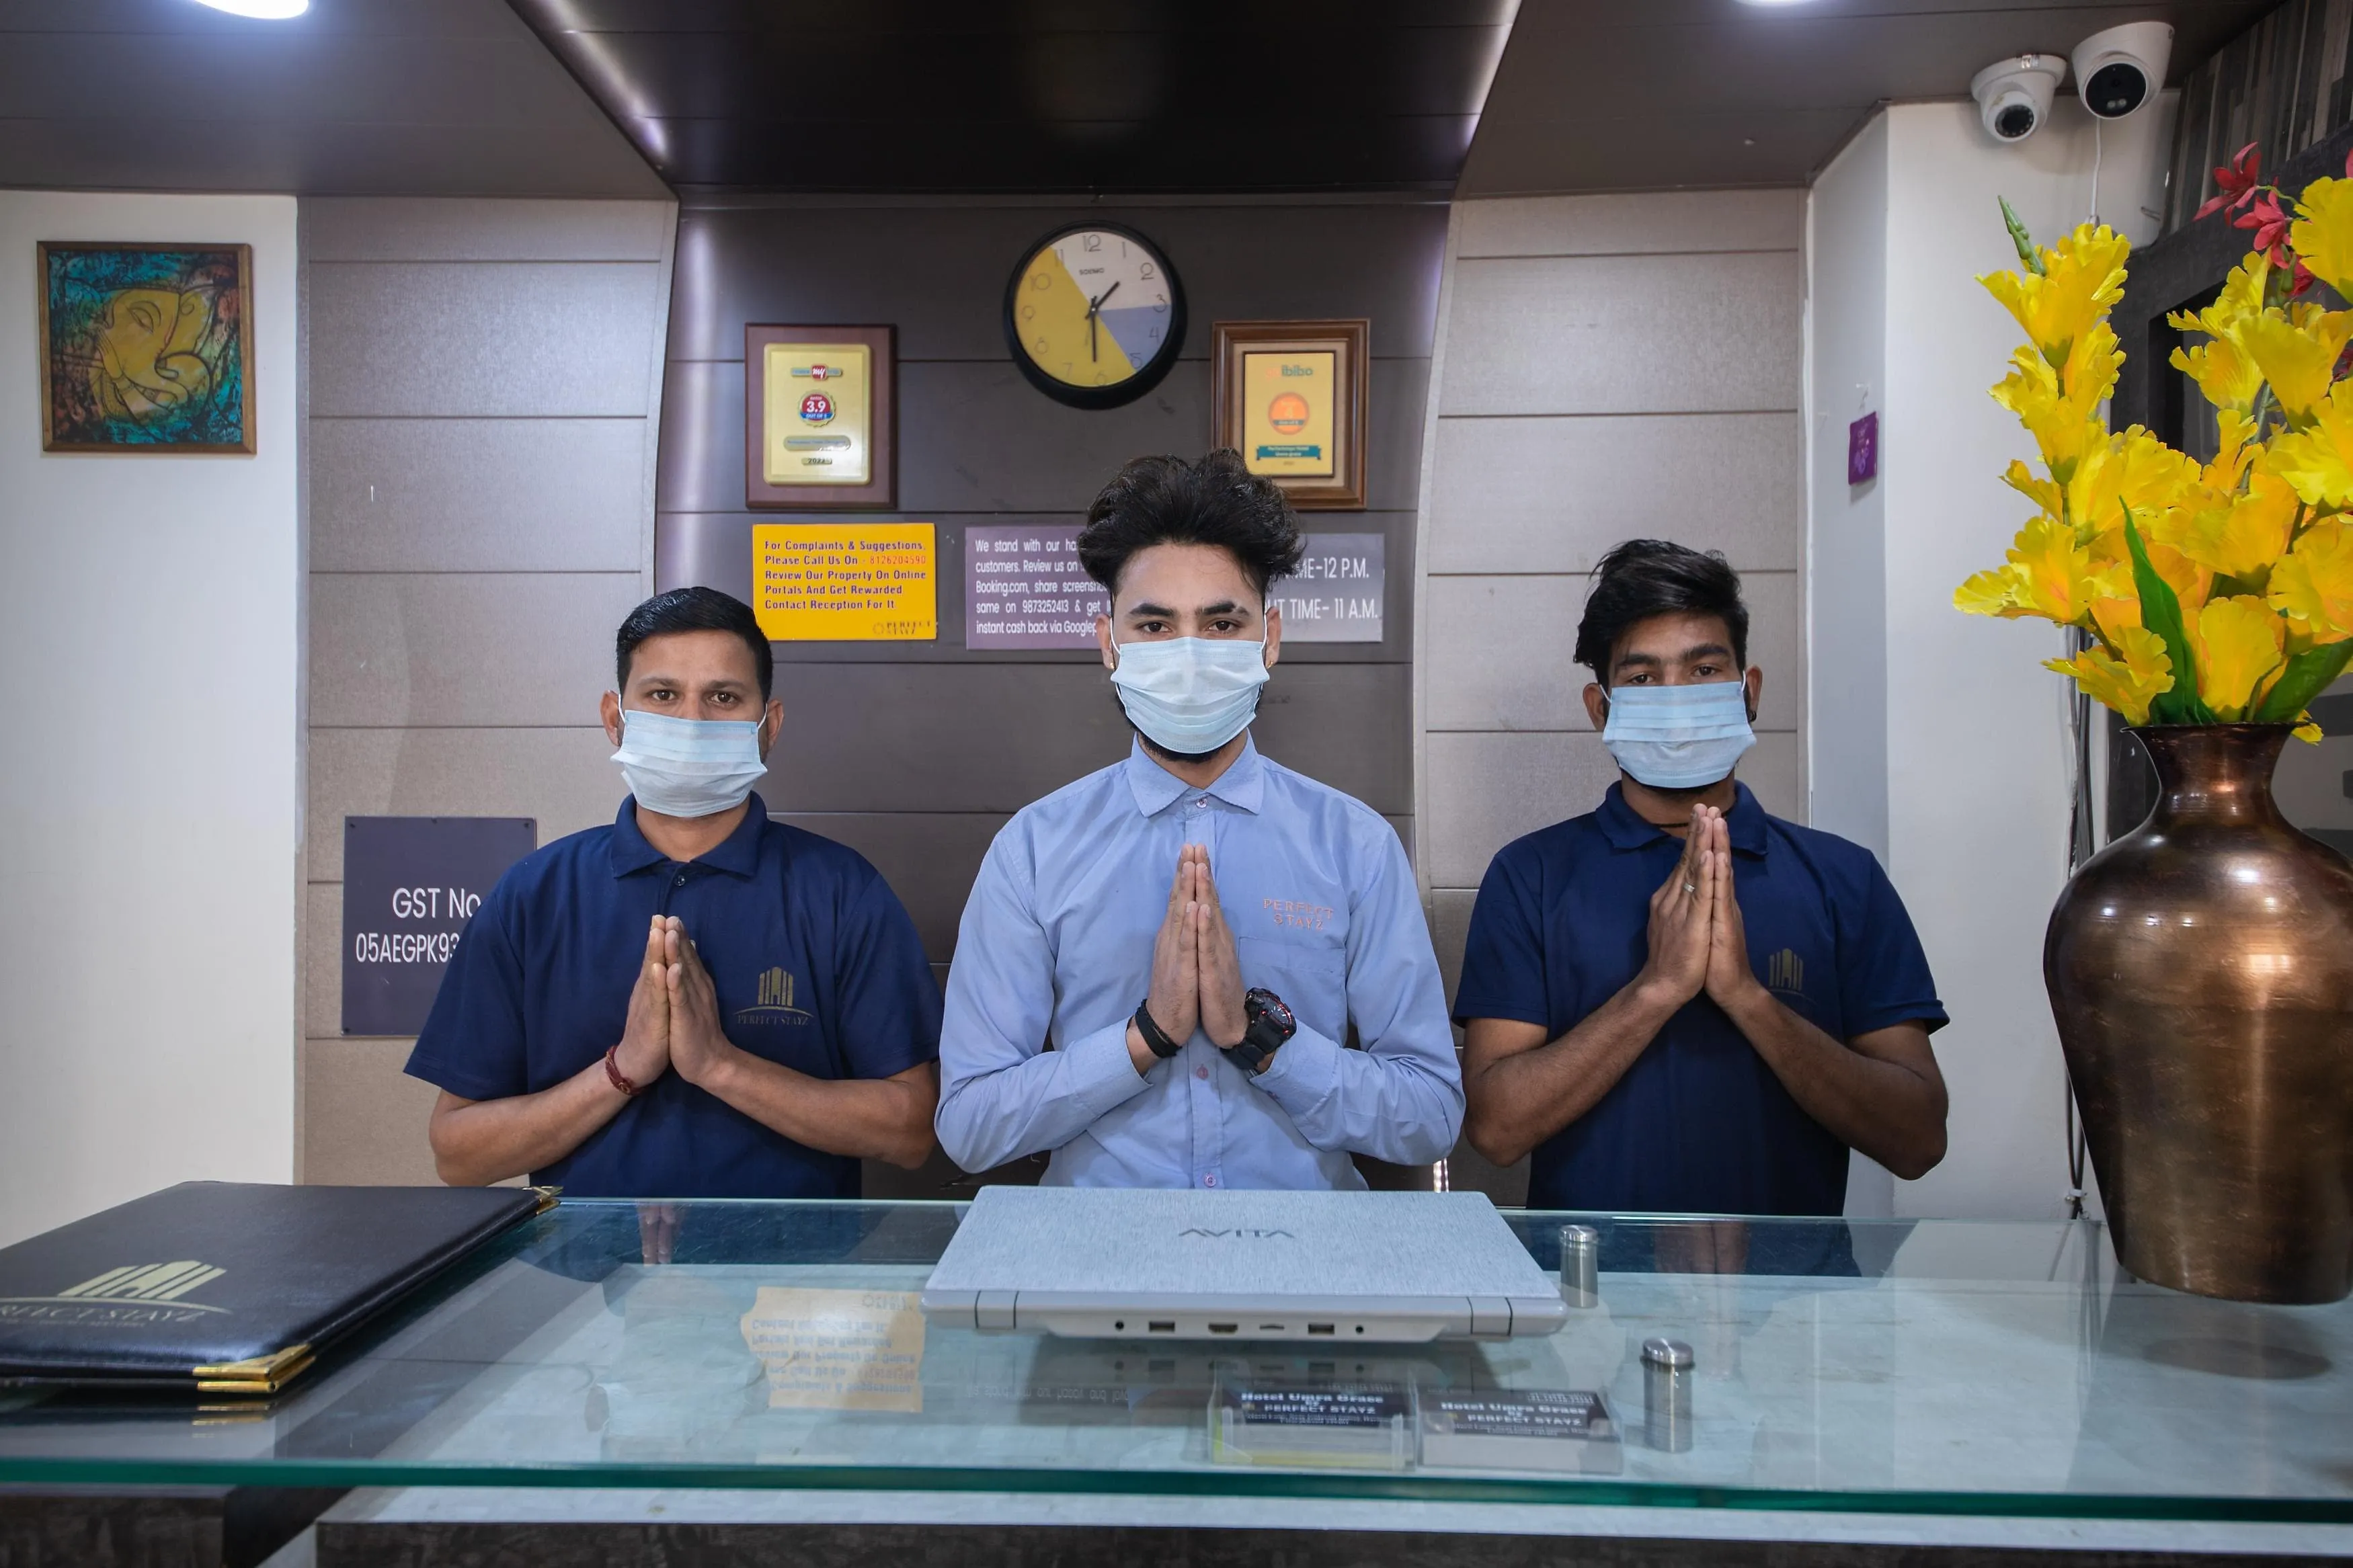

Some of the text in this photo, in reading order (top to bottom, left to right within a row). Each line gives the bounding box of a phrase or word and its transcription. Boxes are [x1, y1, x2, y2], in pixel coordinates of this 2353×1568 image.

[1083, 235, 1101, 252] 12
[1122, 242, 1126, 258] 1
[1055, 249, 1064, 267] 11
[1140, 262, 1154, 280] 2
[1031, 274, 1051, 292] 10
[1152, 294, 1167, 313] 3
[1021, 305, 1035, 321] 9
[1149, 327, 1160, 344] 4
[1034, 337, 1048, 354] 8
[1129, 353, 1144, 369] 5
[1062, 362, 1073, 378] 7
[1094, 370, 1108, 386] 6
[807, 401, 826, 413] 3.9
[764, 541, 781, 550] For
[785, 541, 844, 551] Complaints
[848, 541, 854, 550] &
[975, 540, 990, 552] We
[994, 540, 1018, 552] stand
[1024, 539, 1041, 552] with
[1046, 541, 1060, 551] our
[764, 556, 799, 565] Please
[804, 556, 824, 565] Call
[828, 556, 840, 565] Us
[844, 556, 858, 565] On
[870, 555, 926, 565] 8126204590
[975, 561, 1021, 573] customers.
[1023, 560, 1052, 573] Review
[1055, 562, 1064, 572] us
[1067, 562, 1078, 572] on
[765, 570, 926, 581] Review Our Property On Online
[765, 585, 902, 594] Portals And Get Rewarded
[1035, 581, 1058, 592] share
[765, 600, 806, 609] Contact
[811, 600, 863, 610] Reception
[867, 600, 883, 609] For
[976, 602, 1000, 613] same
[1006, 602, 1016, 613] on
[1023, 600, 1069, 612] 9873252413
[1075, 601, 1081, 612] &
[1087, 600, 1101, 616] get
[1334, 598, 1343, 619] 11
[976, 622, 1004, 634] instant
[1006, 622, 1025, 634] cash
[1028, 621, 1048, 633] back
[1049, 621, 1062, 633] via
[392, 887, 441, 919] GST
[1263, 899, 1334, 920] PERFECT
[356, 933, 459, 964] 05AEGPK93
[1179, 1228, 1295, 1238] AVITA
